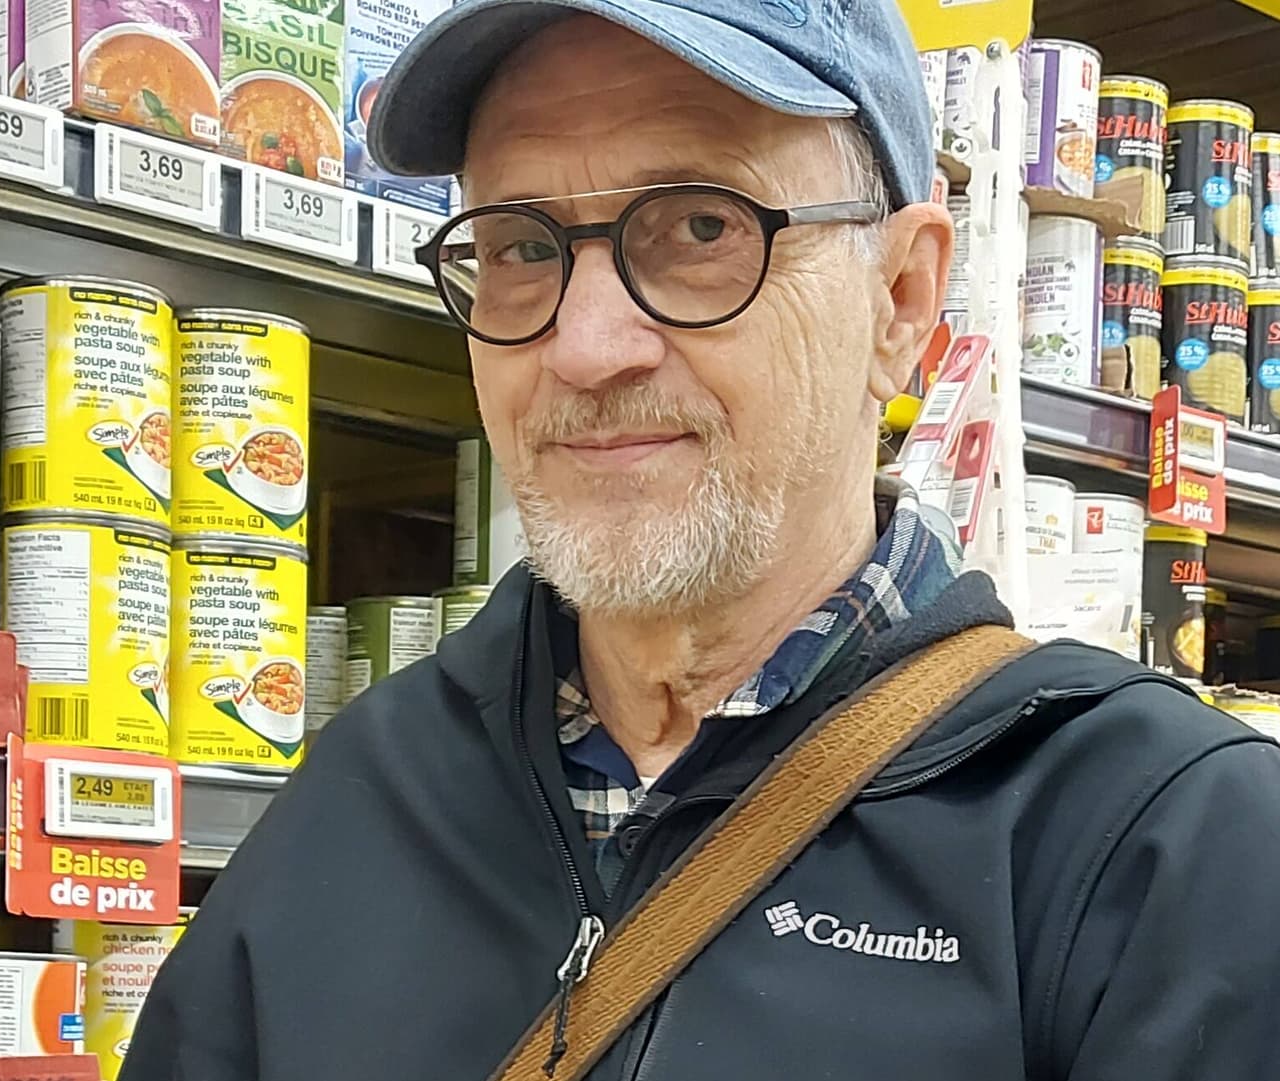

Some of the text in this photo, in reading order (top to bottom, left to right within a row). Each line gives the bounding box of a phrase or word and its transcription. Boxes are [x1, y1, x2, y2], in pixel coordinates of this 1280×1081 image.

[221, 31, 336, 83] BISQUE
[139, 149, 183, 182] 3,69
[283, 188, 324, 219] 3,69
[74, 324, 159, 347] vegetable with
[74, 337, 145, 356] pasta soup
[207, 341, 238, 352] chunky
[74, 354, 140, 373] soupe aux
[180, 351, 271, 369] vegetable with
[74, 369, 144, 387] avec pâtes
[180, 364, 251, 380] pasta soup
[180, 383, 294, 405] soupe aux légumes
[180, 396, 248, 410] avec pâtes
[92, 425, 129, 442] Simple
[195, 448, 230, 464] Simple
[1183, 502, 1214, 524] prix
[118, 566, 164, 584] vegetable
[118, 579, 149, 594] pasta
[190, 584, 279, 601] vegetable with
[118, 598, 152, 613] soupe
[190, 598, 260, 613] pasta soup
[118, 611, 144, 622] avec
[190, 615, 298, 634] soupe aux légumes
[189, 628, 258, 641] avec pâtes
[206, 681, 242, 696] Simple
[77, 777, 113, 799] 2,49
[51, 847, 147, 880] Baisse
[50, 878, 155, 913] de prix
[804, 913, 960, 962] Columbia
[102, 943, 154, 956] chicken
[102, 962, 146, 976] soupe
